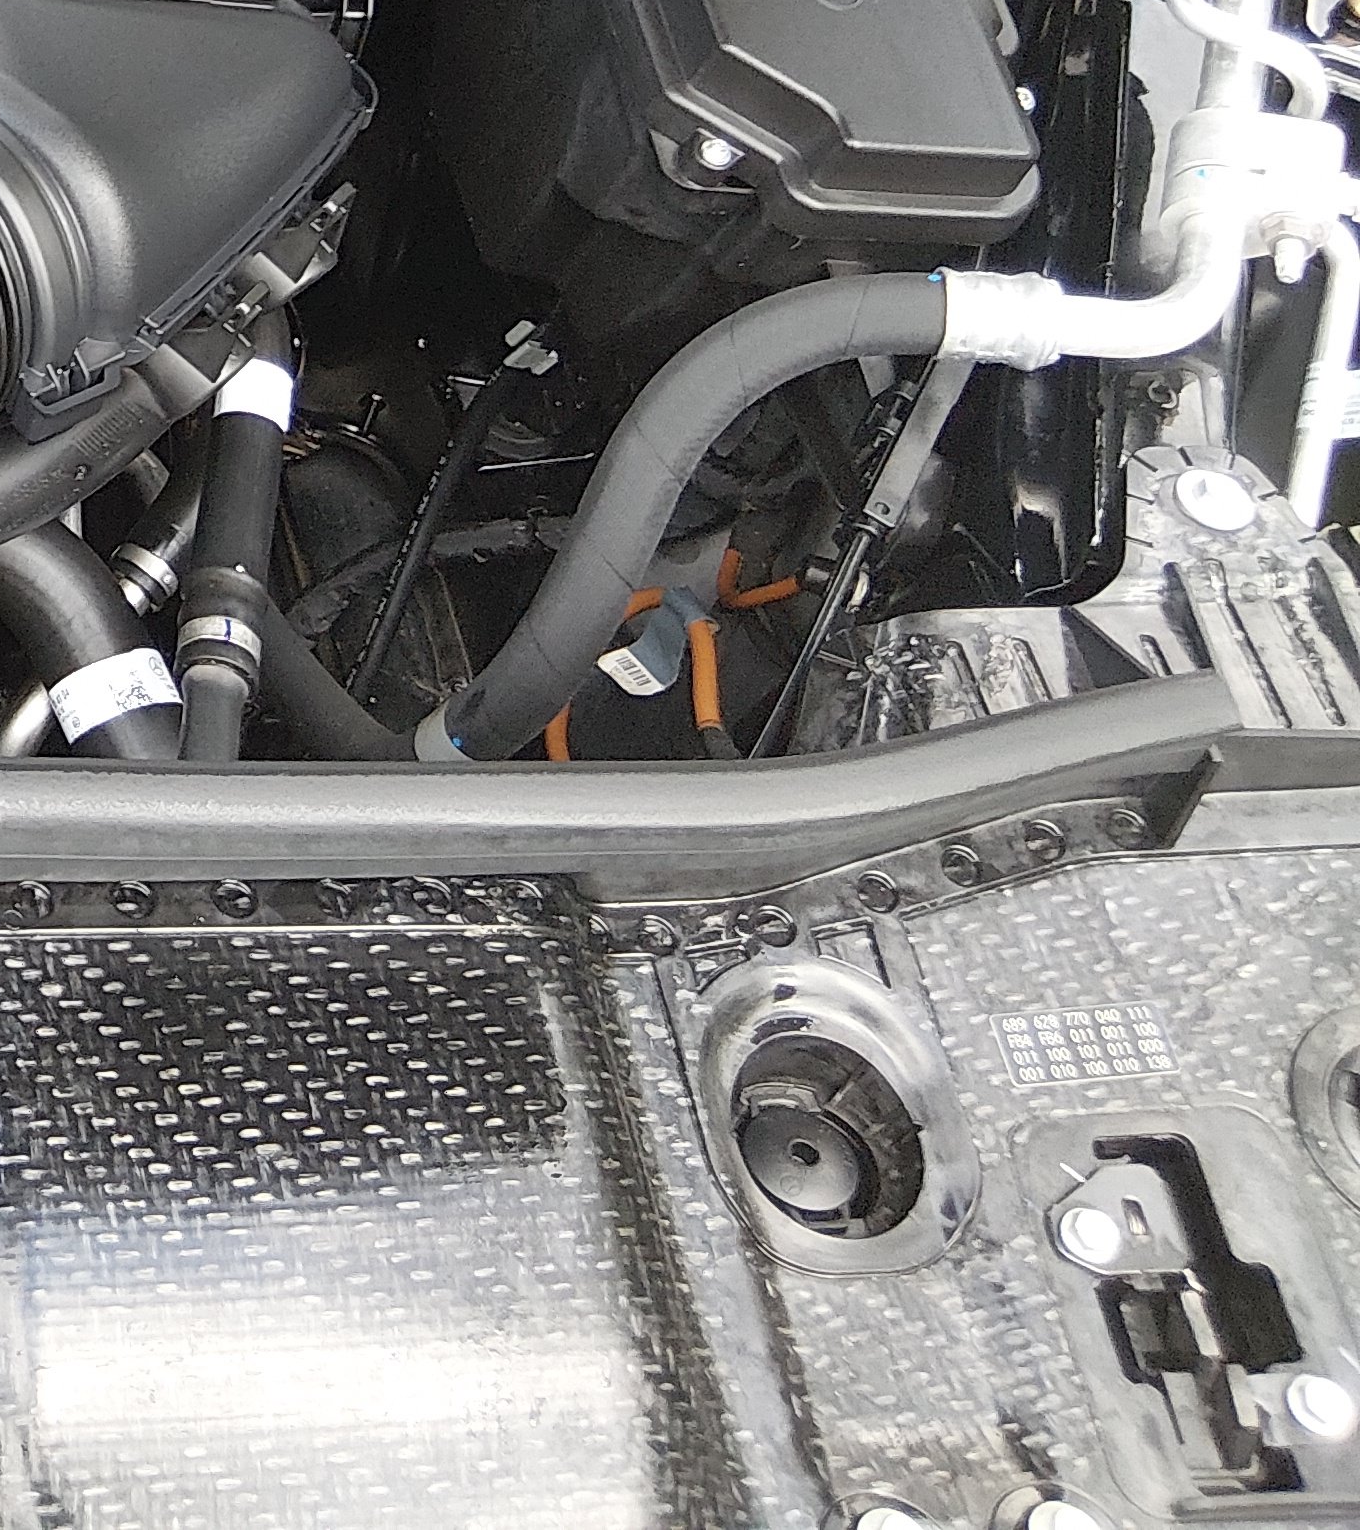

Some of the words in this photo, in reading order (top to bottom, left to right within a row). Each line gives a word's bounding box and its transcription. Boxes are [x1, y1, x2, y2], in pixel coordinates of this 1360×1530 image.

[1126, 1006, 1152, 1021] 111
[1069, 1028, 1096, 1044] 011
[1100, 1025, 1126, 1040] 001
[1013, 1050, 1039, 1066] 011
[1045, 1048, 1071, 1063] 100
[1106, 1042, 1133, 1057] 011
[1018, 1066, 1046, 1082] 001
